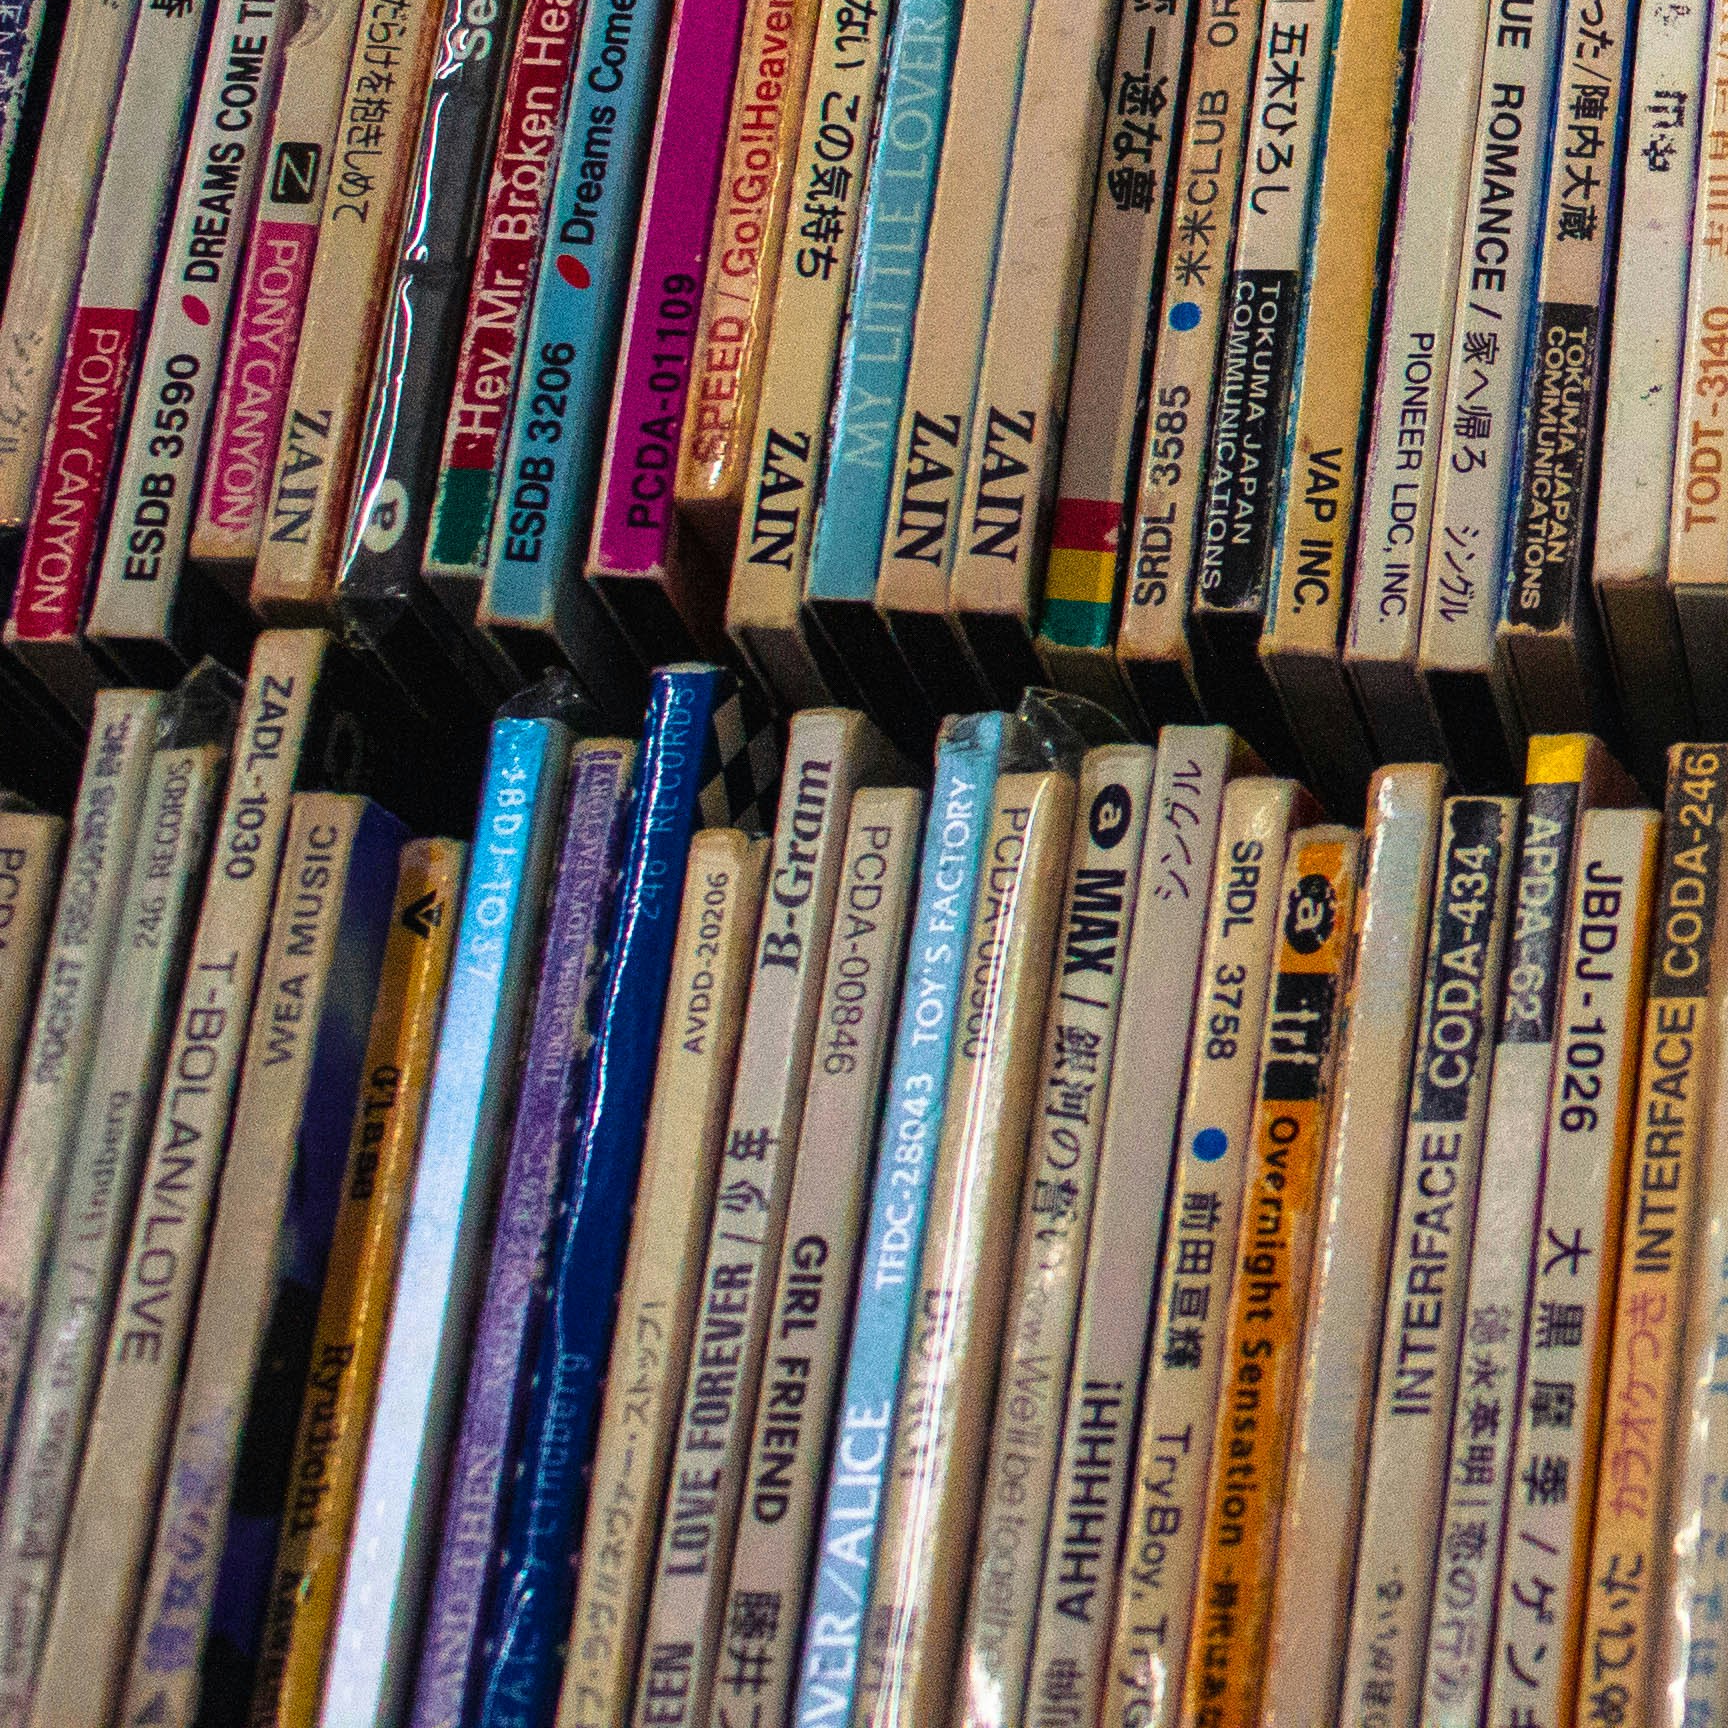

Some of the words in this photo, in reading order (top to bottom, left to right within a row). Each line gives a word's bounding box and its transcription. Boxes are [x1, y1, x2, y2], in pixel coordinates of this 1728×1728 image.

[269, 409, 332, 546] ZAIN
[628, 274, 695, 530] PCDA-01109
[895, 409, 962, 567] ZAIN
[971, 406, 1034, 564] ZAIN
[1303, 448, 1343, 523] VAP
[1400, 332, 1435, 470] PIONEER
[27, 425, 96, 615] CANYON
[751, 428, 810, 570] ZAIN
[761, 759, 832, 973] B-Gram
[1664, 748, 1721, 979] CODA-246
[685, 870, 730, 1054] AVDD-20206
[1431, 841, 1490, 1089] CODA-434
[116, 951, 239, 1365] T-BOLAN/LOVE
[1635, 1004, 1701, 1274] INTERFACE
[1391, 1130, 1459, 1419] INTERFACE
